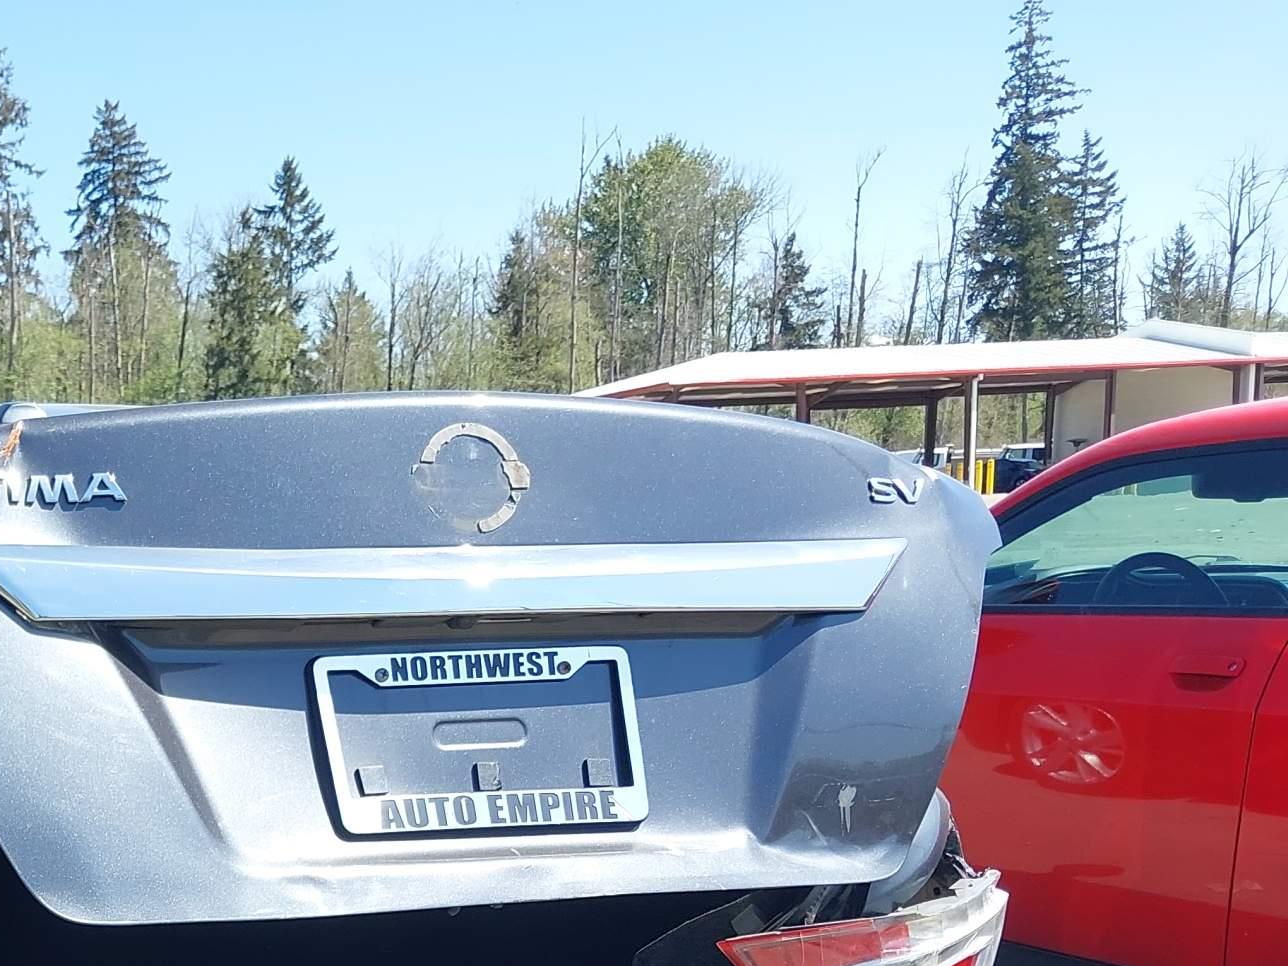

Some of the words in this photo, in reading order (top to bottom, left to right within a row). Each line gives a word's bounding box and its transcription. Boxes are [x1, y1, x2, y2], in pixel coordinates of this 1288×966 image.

[866, 477, 925, 505] SV
[390, 651, 559, 682] NORTHWEST
[380, 795, 478, 830] AUTO
[487, 790, 618, 824] EMPIRE
